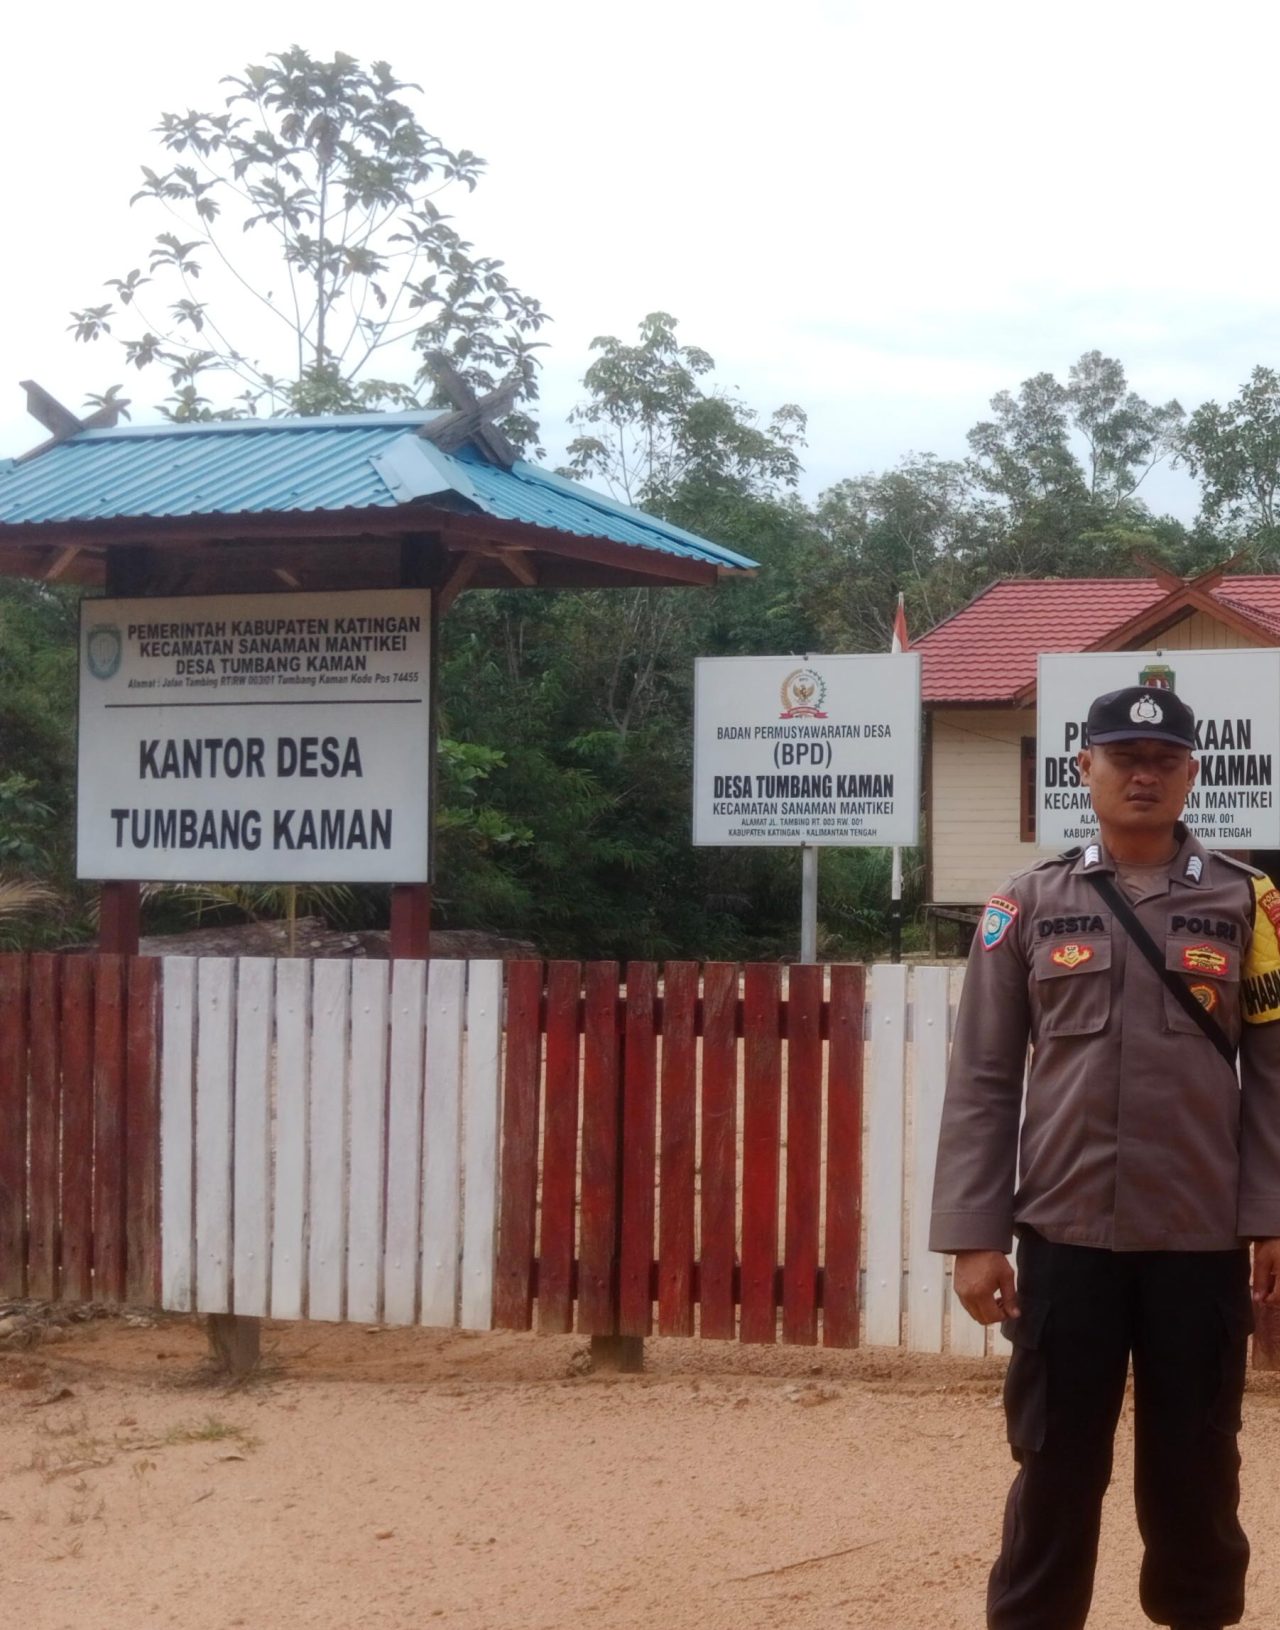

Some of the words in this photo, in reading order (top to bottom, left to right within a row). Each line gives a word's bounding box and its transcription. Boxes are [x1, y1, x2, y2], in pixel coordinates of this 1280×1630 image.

[128, 622, 226, 641] PEMERINTAH
[232, 618, 329, 638] KABUPATEN
[334, 616, 421, 635] KATINGAN
[140, 640, 234, 658] KECAMATAN
[238, 637, 320, 655] SANAMAN
[325, 634, 408, 653] MANTIKEI
[176, 658, 216, 676] DESA
[221, 656, 302, 675] TUMBANG
[306, 655, 367, 673] KAMAN
[128, 678, 156, 689] Alamat
[162, 677, 184, 688] Jalan
[185, 677, 218, 689] Tambing
[277, 675, 317, 688] Tumbang
[319, 674, 349, 685] Kaman
[351, 673, 373, 684] Kode
[375, 673, 391, 683] Pos
[393, 672, 419, 683] 74455
[717, 727, 751, 740] BADAN
[754, 725, 861, 740] PERMUSYAWARATAN
[864, 725, 892, 738] DESA
[139, 738, 266, 779] KANTOR
[277, 736, 364, 778] DESA
[774, 741, 832, 769] (BPD)
[1045, 757, 1088, 788] DES
[1201, 755, 1272, 786] KAMAN
[714, 775, 753, 799] DESA
[756, 775, 833, 799] TUMBANG
[836, 774, 894, 798] KAMAN
[713, 803, 778, 816] KECAMATAN
[781, 802, 837, 815] SANAMAN
[840, 801, 894, 815] MANTIKEI
[1205, 792, 1272, 809] MANTIKEI
[742, 818, 767, 826] ALAMAT
[823, 818, 835, 826] 003
[852, 818, 863, 826] 001
[1184, 814, 1199, 824] 003
[1201, 814, 1217, 824] RW.
[1220, 814, 1234, 824] 001
[111, 809, 262, 851] TUMBANG
[273, 809, 392, 850] KAMAN
[728, 829, 766, 837] KABUPATEN
[768, 829, 801, 837] KATINGAN
[807, 829, 849, 837] KALIMANTAN
[850, 829, 877, 837] TENGAH
[1218, 828, 1252, 838] TENGAH
[1039, 915, 1105, 937] DESTA
[1172, 915, 1237, 941] POLRI
